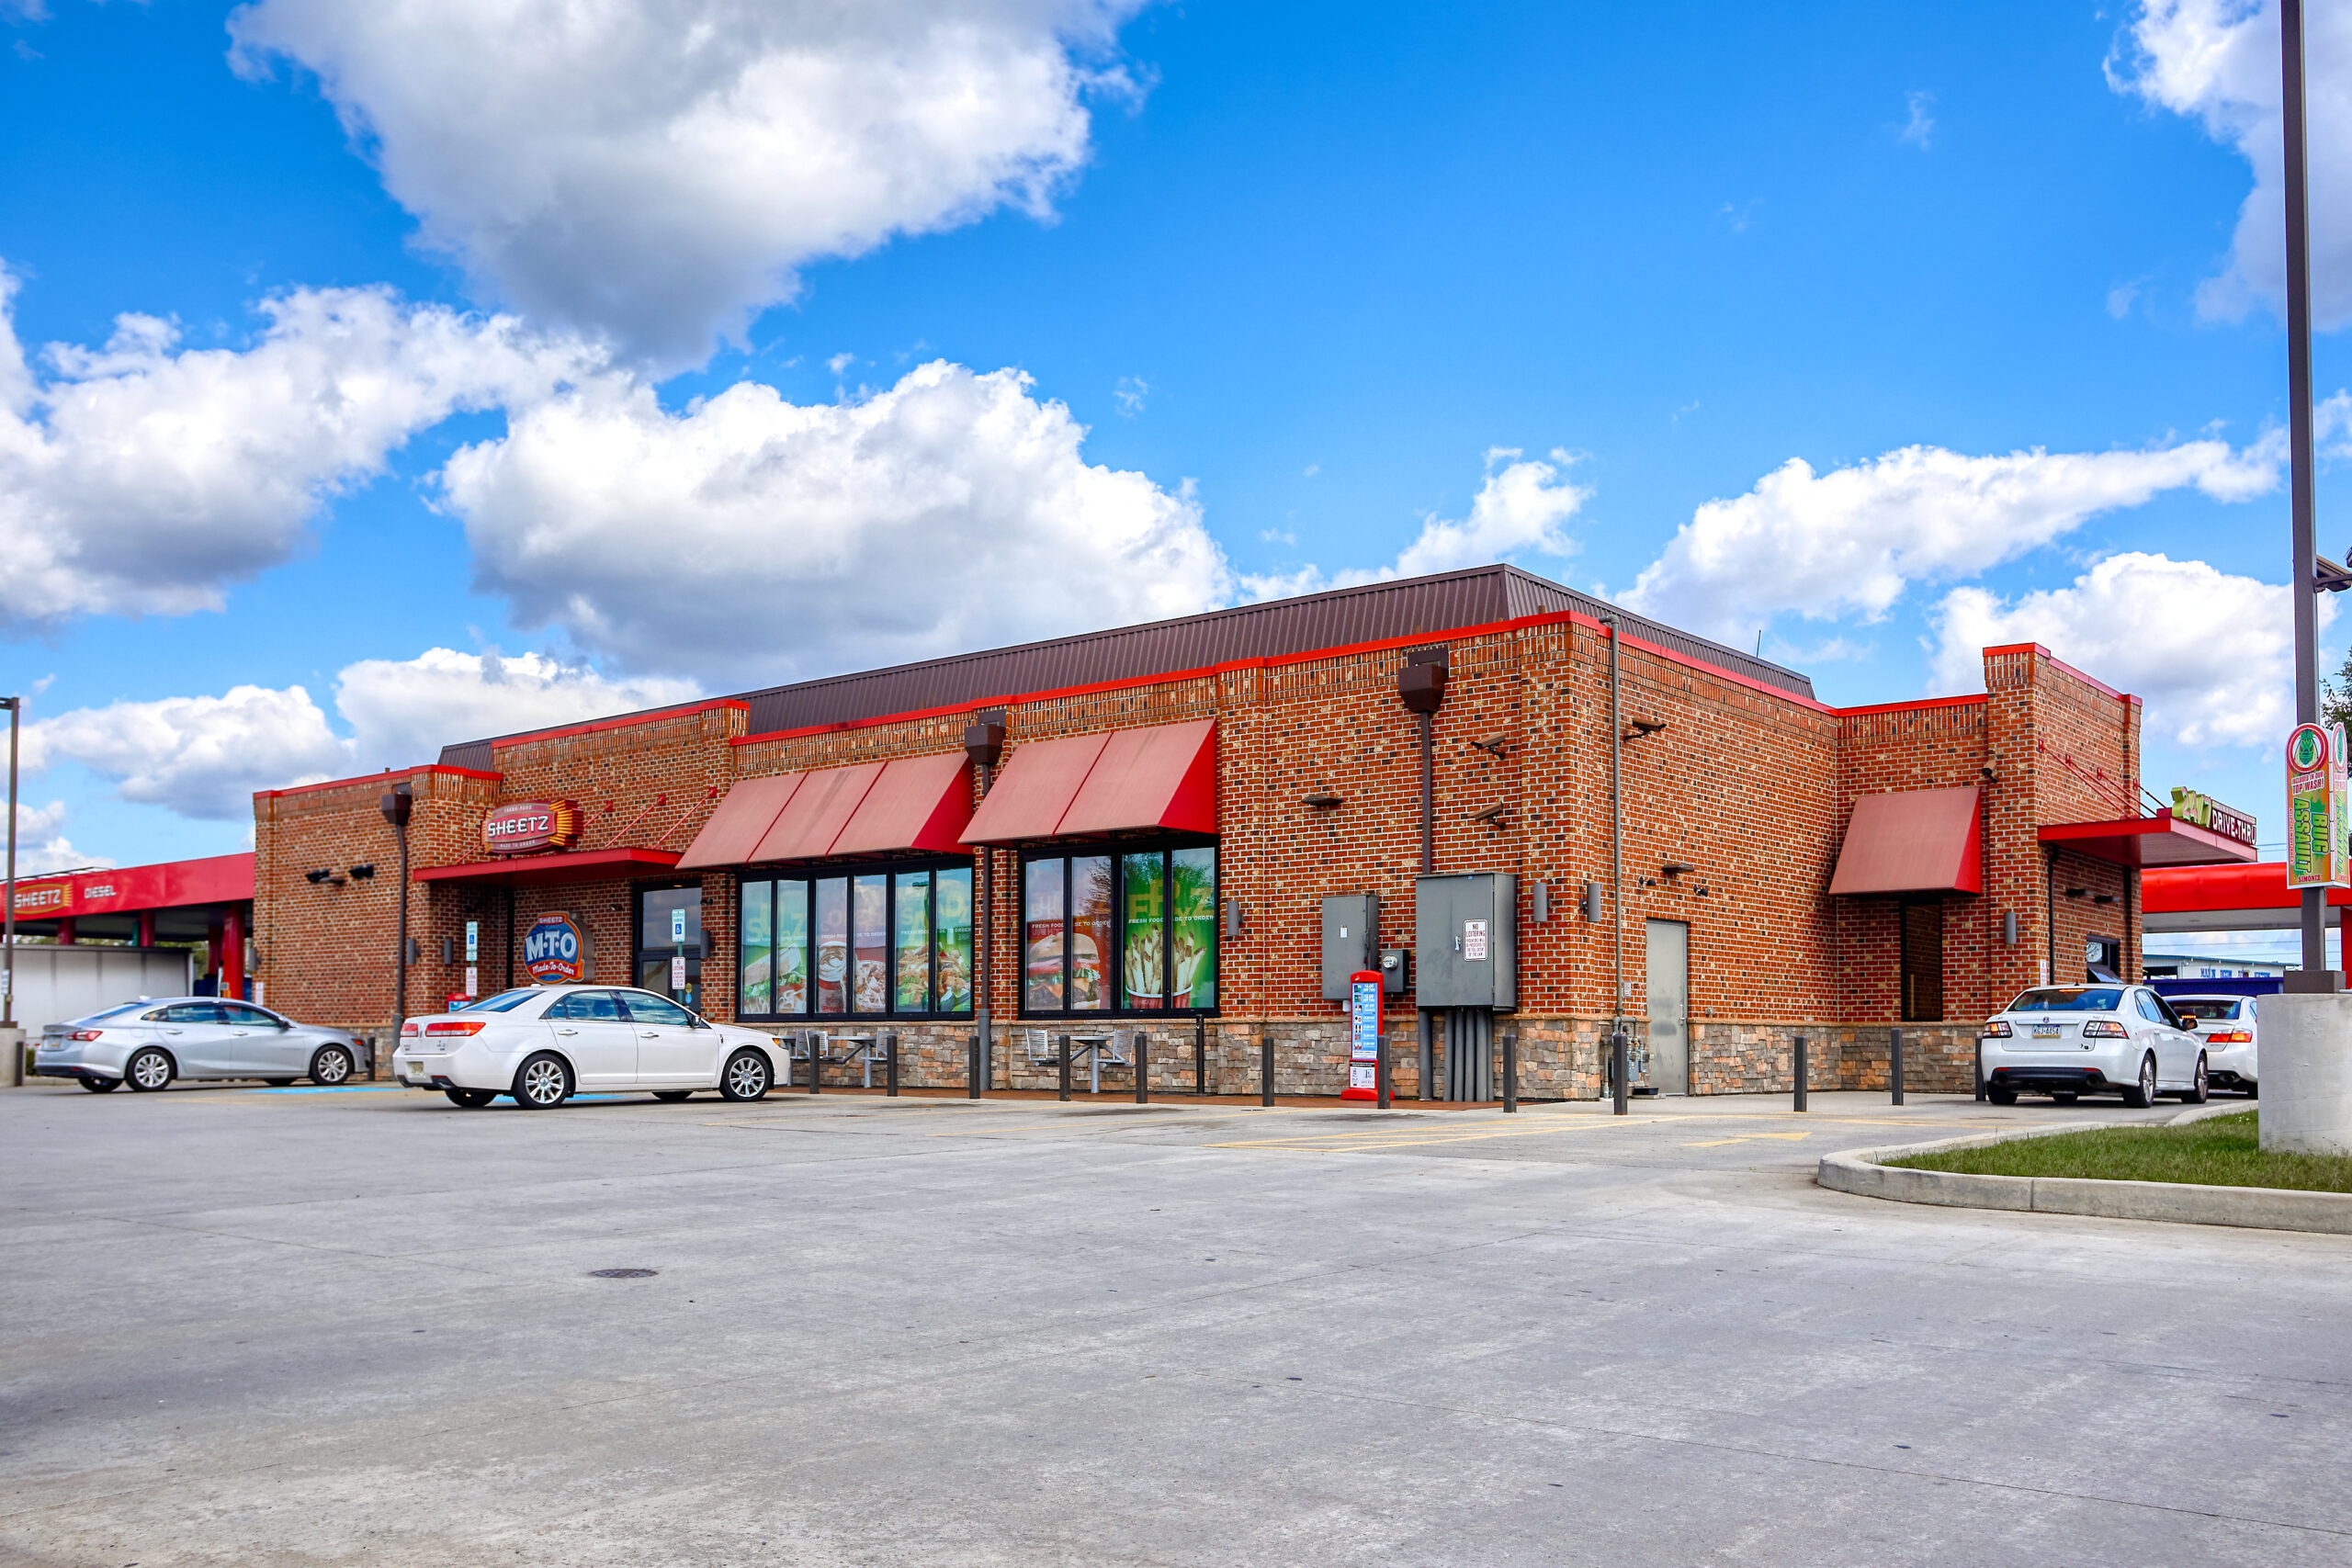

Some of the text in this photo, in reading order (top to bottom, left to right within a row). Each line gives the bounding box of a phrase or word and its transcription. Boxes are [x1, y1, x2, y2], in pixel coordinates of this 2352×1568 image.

[2293, 784, 2302, 795] TOP
[2305, 778, 2324, 791] WASH!
[2174, 786, 2211, 829] 24/7
[488, 816, 548, 837] SHEETZ
[2212, 809, 2256, 845] DRIVE-THRU
[2294, 798, 2312, 873] ASSAULT
[2312, 814, 2329, 853] BUG
[2298, 874, 2321, 883] SIMONIZ
[15, 888, 61, 908] SHEETZ
[84, 885, 117, 899] DIESEL
